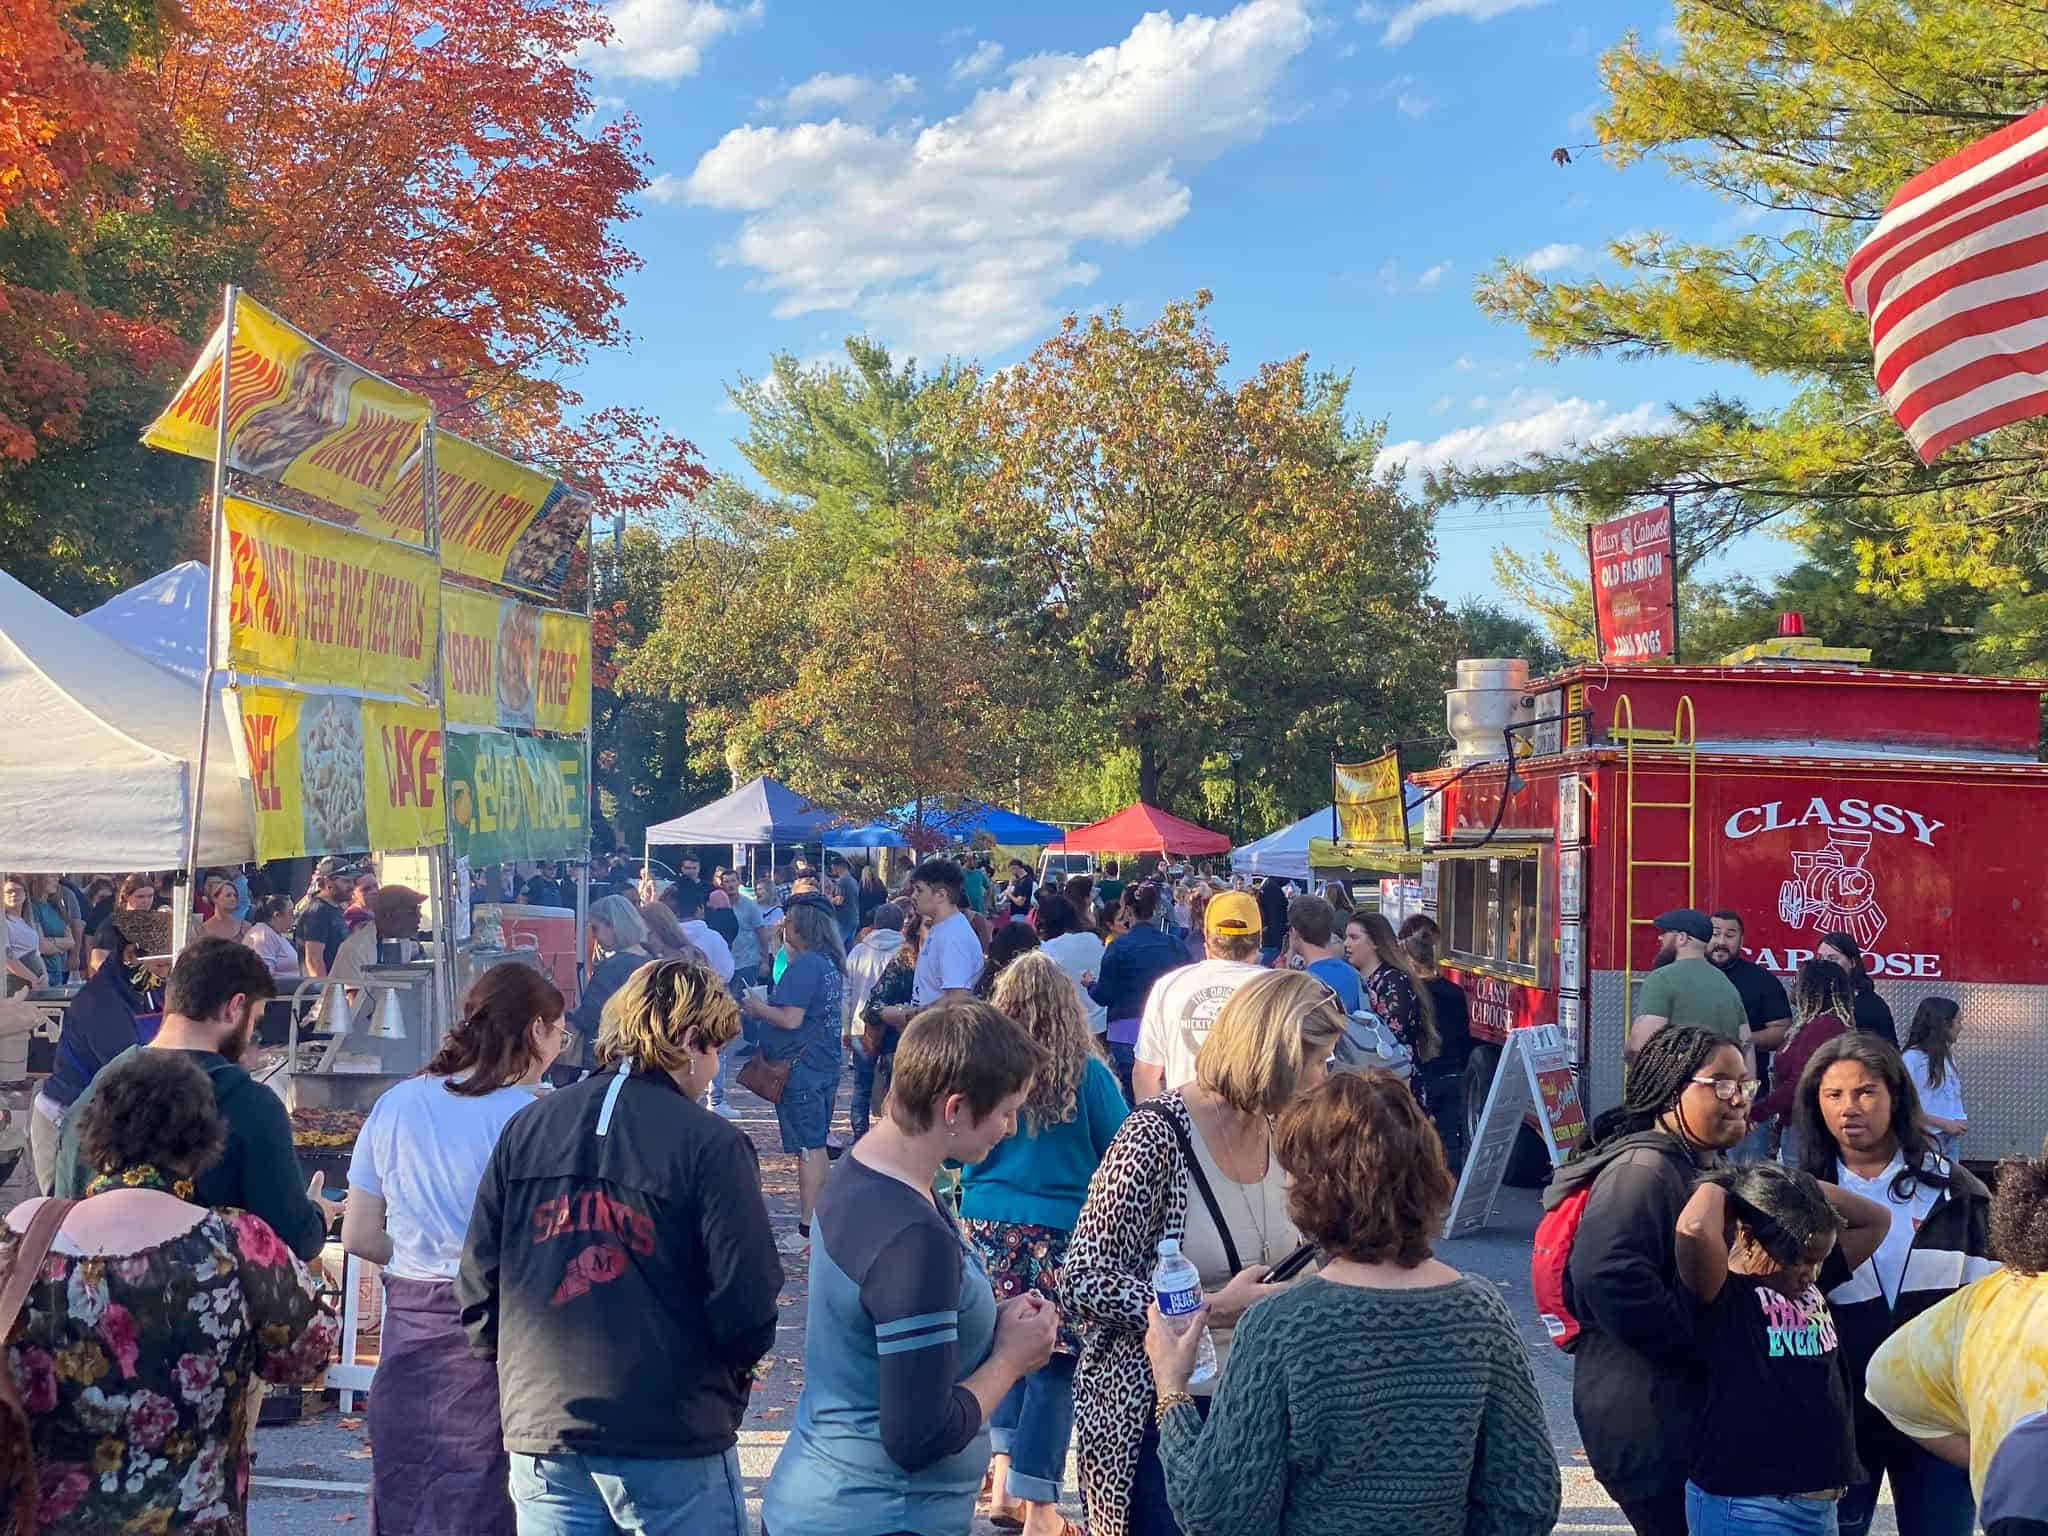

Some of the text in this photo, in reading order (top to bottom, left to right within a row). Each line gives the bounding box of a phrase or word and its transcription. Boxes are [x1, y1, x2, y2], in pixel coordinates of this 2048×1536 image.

[1594, 517, 1669, 553] Classy Caboose
[1601, 552, 1663, 588] OLD FASHION
[1634, 630, 1661, 655] DOGS
[1724, 797, 1945, 847] CLASSY
[1476, 978, 1511, 1006] CLASSY
[1472, 1001, 1514, 1033] CABOOSE
[591, 1255, 612, 1273] M
